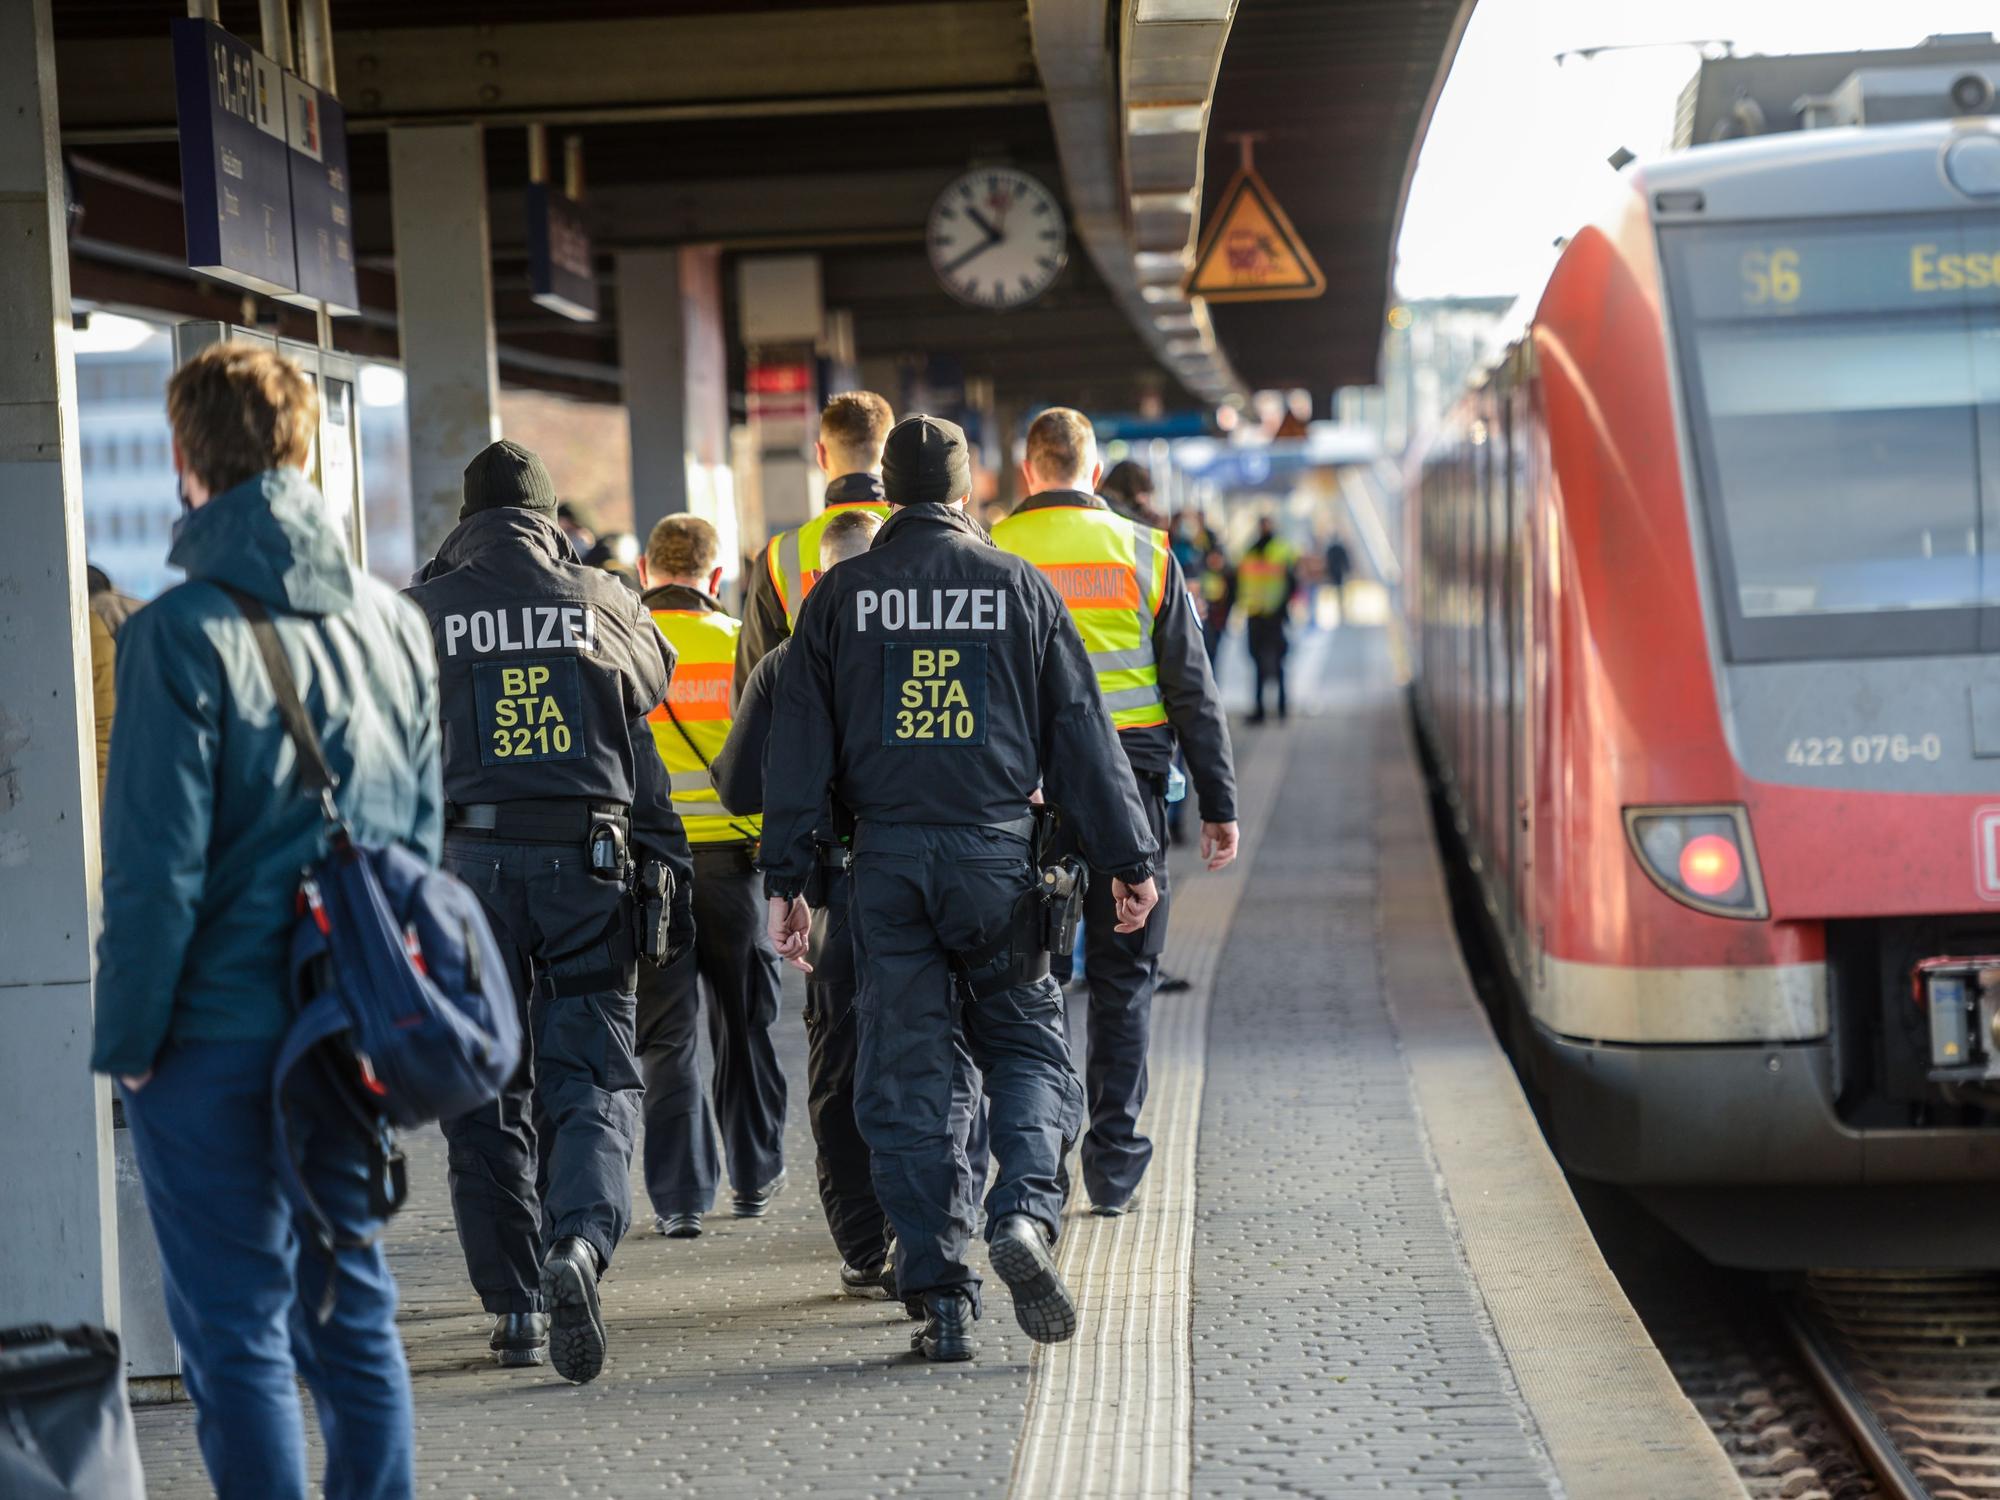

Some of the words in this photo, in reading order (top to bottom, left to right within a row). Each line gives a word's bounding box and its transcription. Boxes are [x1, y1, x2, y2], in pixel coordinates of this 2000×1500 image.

[1743, 248, 1801, 303] S6
[856, 588, 1007, 632] POLIZEI
[444, 607, 596, 656] POLIZEI
[912, 649, 961, 677] BP
[502, 666, 550, 697] BP
[900, 680, 969, 708] STA
[495, 696, 564, 727] STA
[895, 710, 974, 739] 3210
[493, 725, 571, 758] 3210
[1786, 736, 1844, 767] 422
